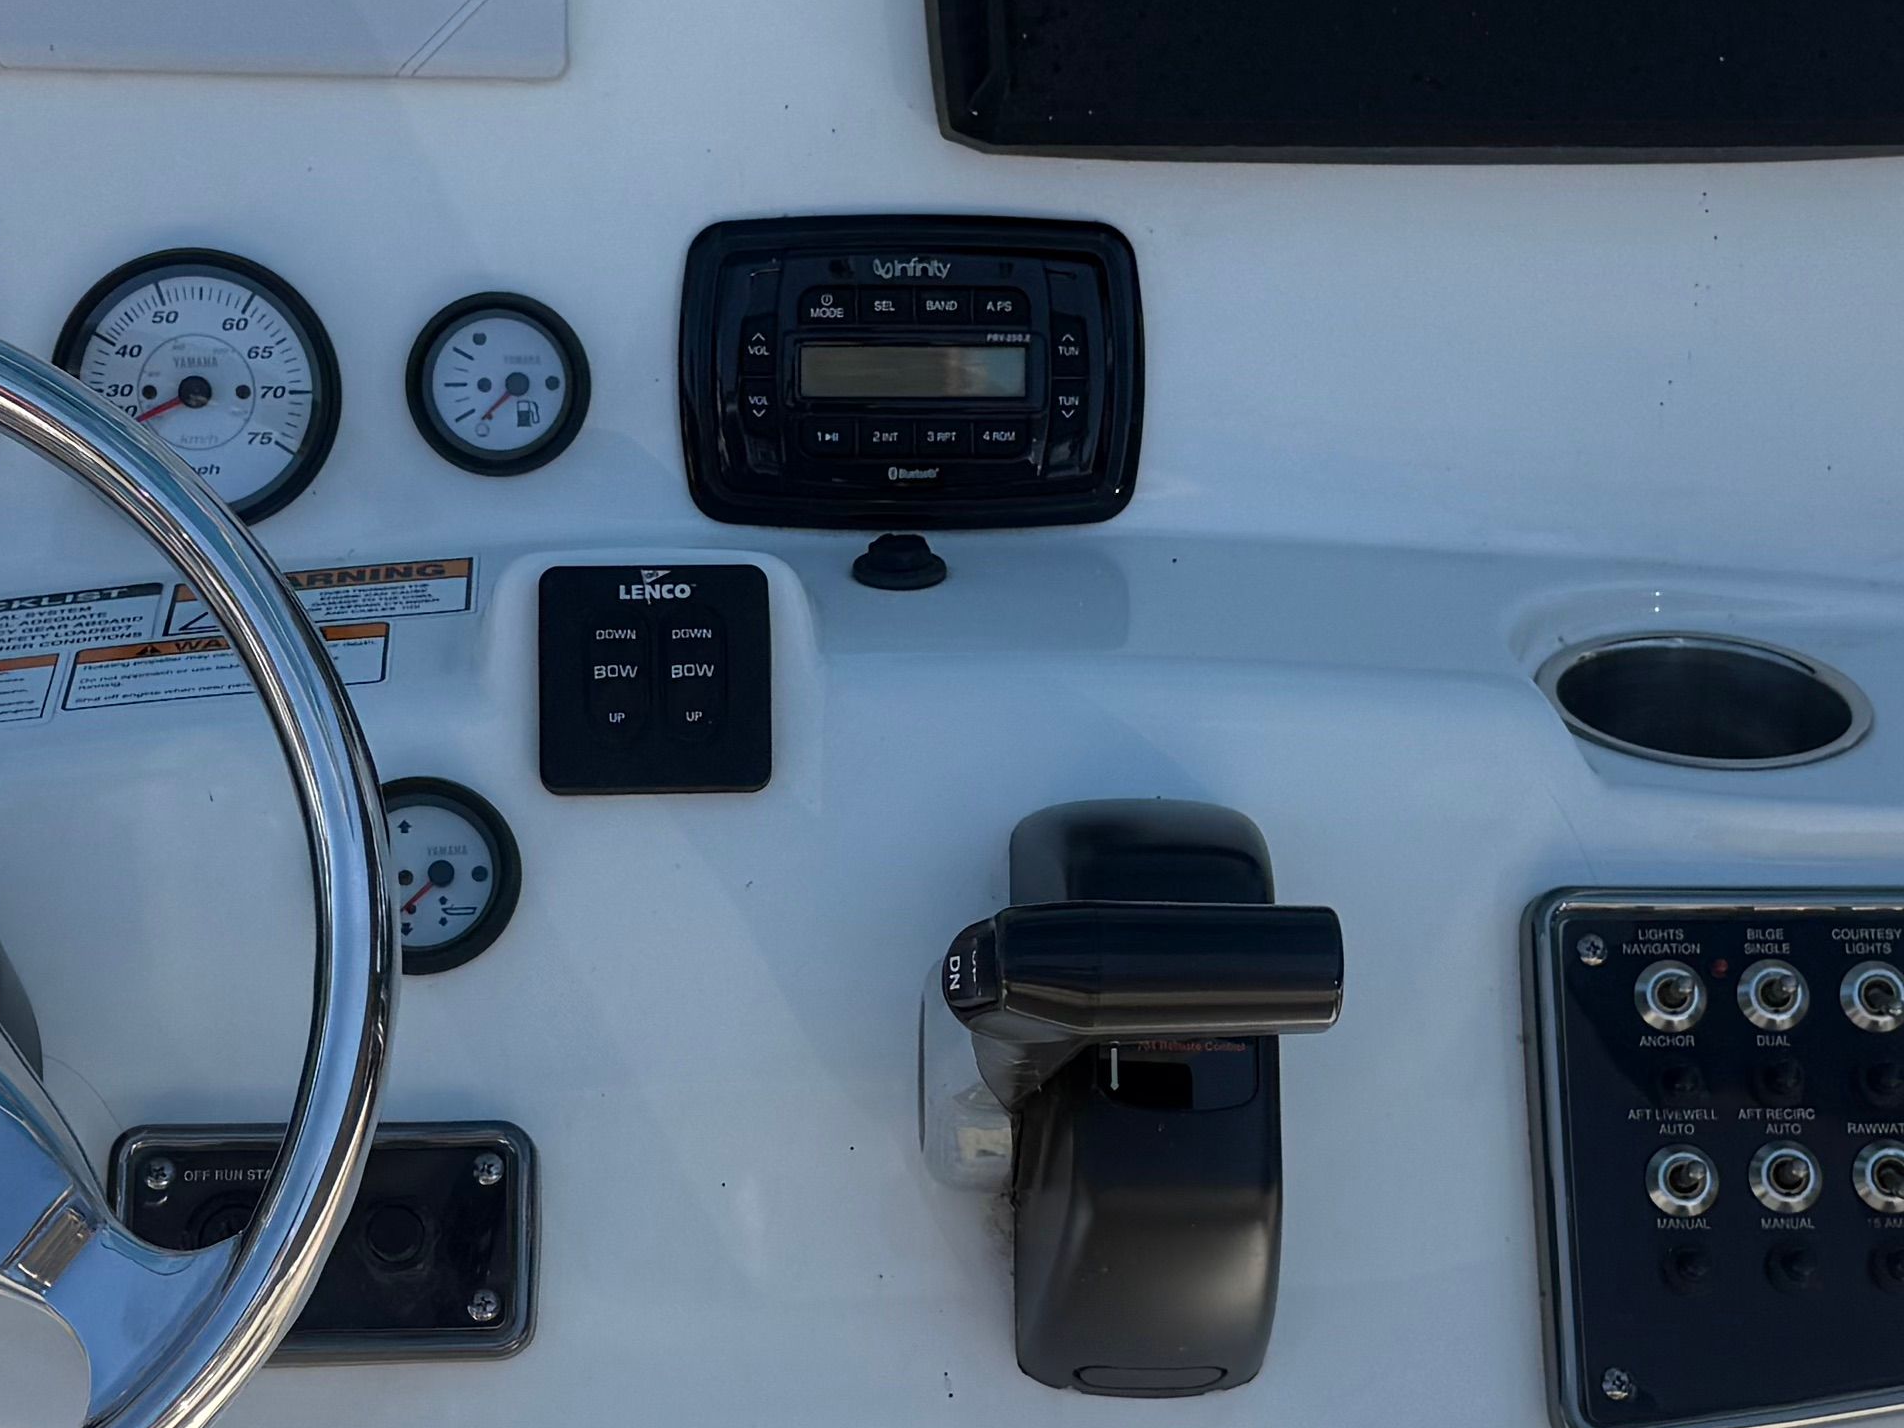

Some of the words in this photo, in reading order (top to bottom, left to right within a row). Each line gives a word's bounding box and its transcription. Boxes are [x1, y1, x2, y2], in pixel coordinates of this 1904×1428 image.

[874, 300, 896, 312] SEL
[925, 300, 958, 311] BAND
[151, 309, 179, 325] 50
[810, 307, 844, 318] MODE
[221, 317, 249, 332] 60
[115, 344, 143, 358] 40
[246, 345, 275, 360] 65
[748, 345, 770, 356] VOL
[1058, 345, 1079, 356] TUN
[172, 356, 219, 368] YAMAHA
[105, 383, 134, 397] 30
[259, 385, 286, 400] 70
[748, 395, 769, 406] VOL
[1058, 396, 1079, 406] TUN
[247, 431, 273, 446] 75
[872, 432, 880, 442] 2
[927, 431, 935, 442] 3
[982, 431, 990, 442] 4
[618, 583, 692, 601] LENCO
[25, 605, 92, 619] SYSTEM
[19, 612, 108, 626] ADEQUATE
[21, 620, 69, 633] GEAR
[73, 615, 144, 628] ABOARD
[55, 624, 133, 638] LOADED?
[596, 629, 637, 640] DOWN
[671, 628, 712, 639] DOWN
[39, 631, 143, 648] CONDITIONS
[594, 664, 638, 679] BOW
[671, 663, 714, 679] BOW
[609, 712, 626, 722] UP
[686, 711, 703, 721] UP
[1638, 929, 1684, 940] LIGHTS
[1746, 928, 1784, 940] BILGE
[1831, 928, 1903, 940] COURTESY
[1622, 943, 1701, 954] NAVIGATION
[1744, 943, 1791, 954] SINGLE
[1845, 943, 1892, 954] LIGHTS
[949, 955, 961, 990] DN
[1639, 1035, 1696, 1047] ANCHOR
[1756, 1035, 1791, 1047] DUAL
[1628, 1108, 1651, 1120] AFT
[1655, 1108, 1718, 1120] LIVEWELL
[1738, 1108, 1763, 1120] AFT
[1765, 1108, 1816, 1120] RECIRC
[1659, 1123, 1695, 1135] AUTO
[1765, 1123, 1802, 1135] AUTO
[183, 1170, 211, 1182] OFF
[214, 1169, 243, 1181] RUN
[247, 1168, 273, 1181] STA
[1656, 1218, 1711, 1229] MANUAL
[1760, 1218, 1816, 1229] MANUAL
